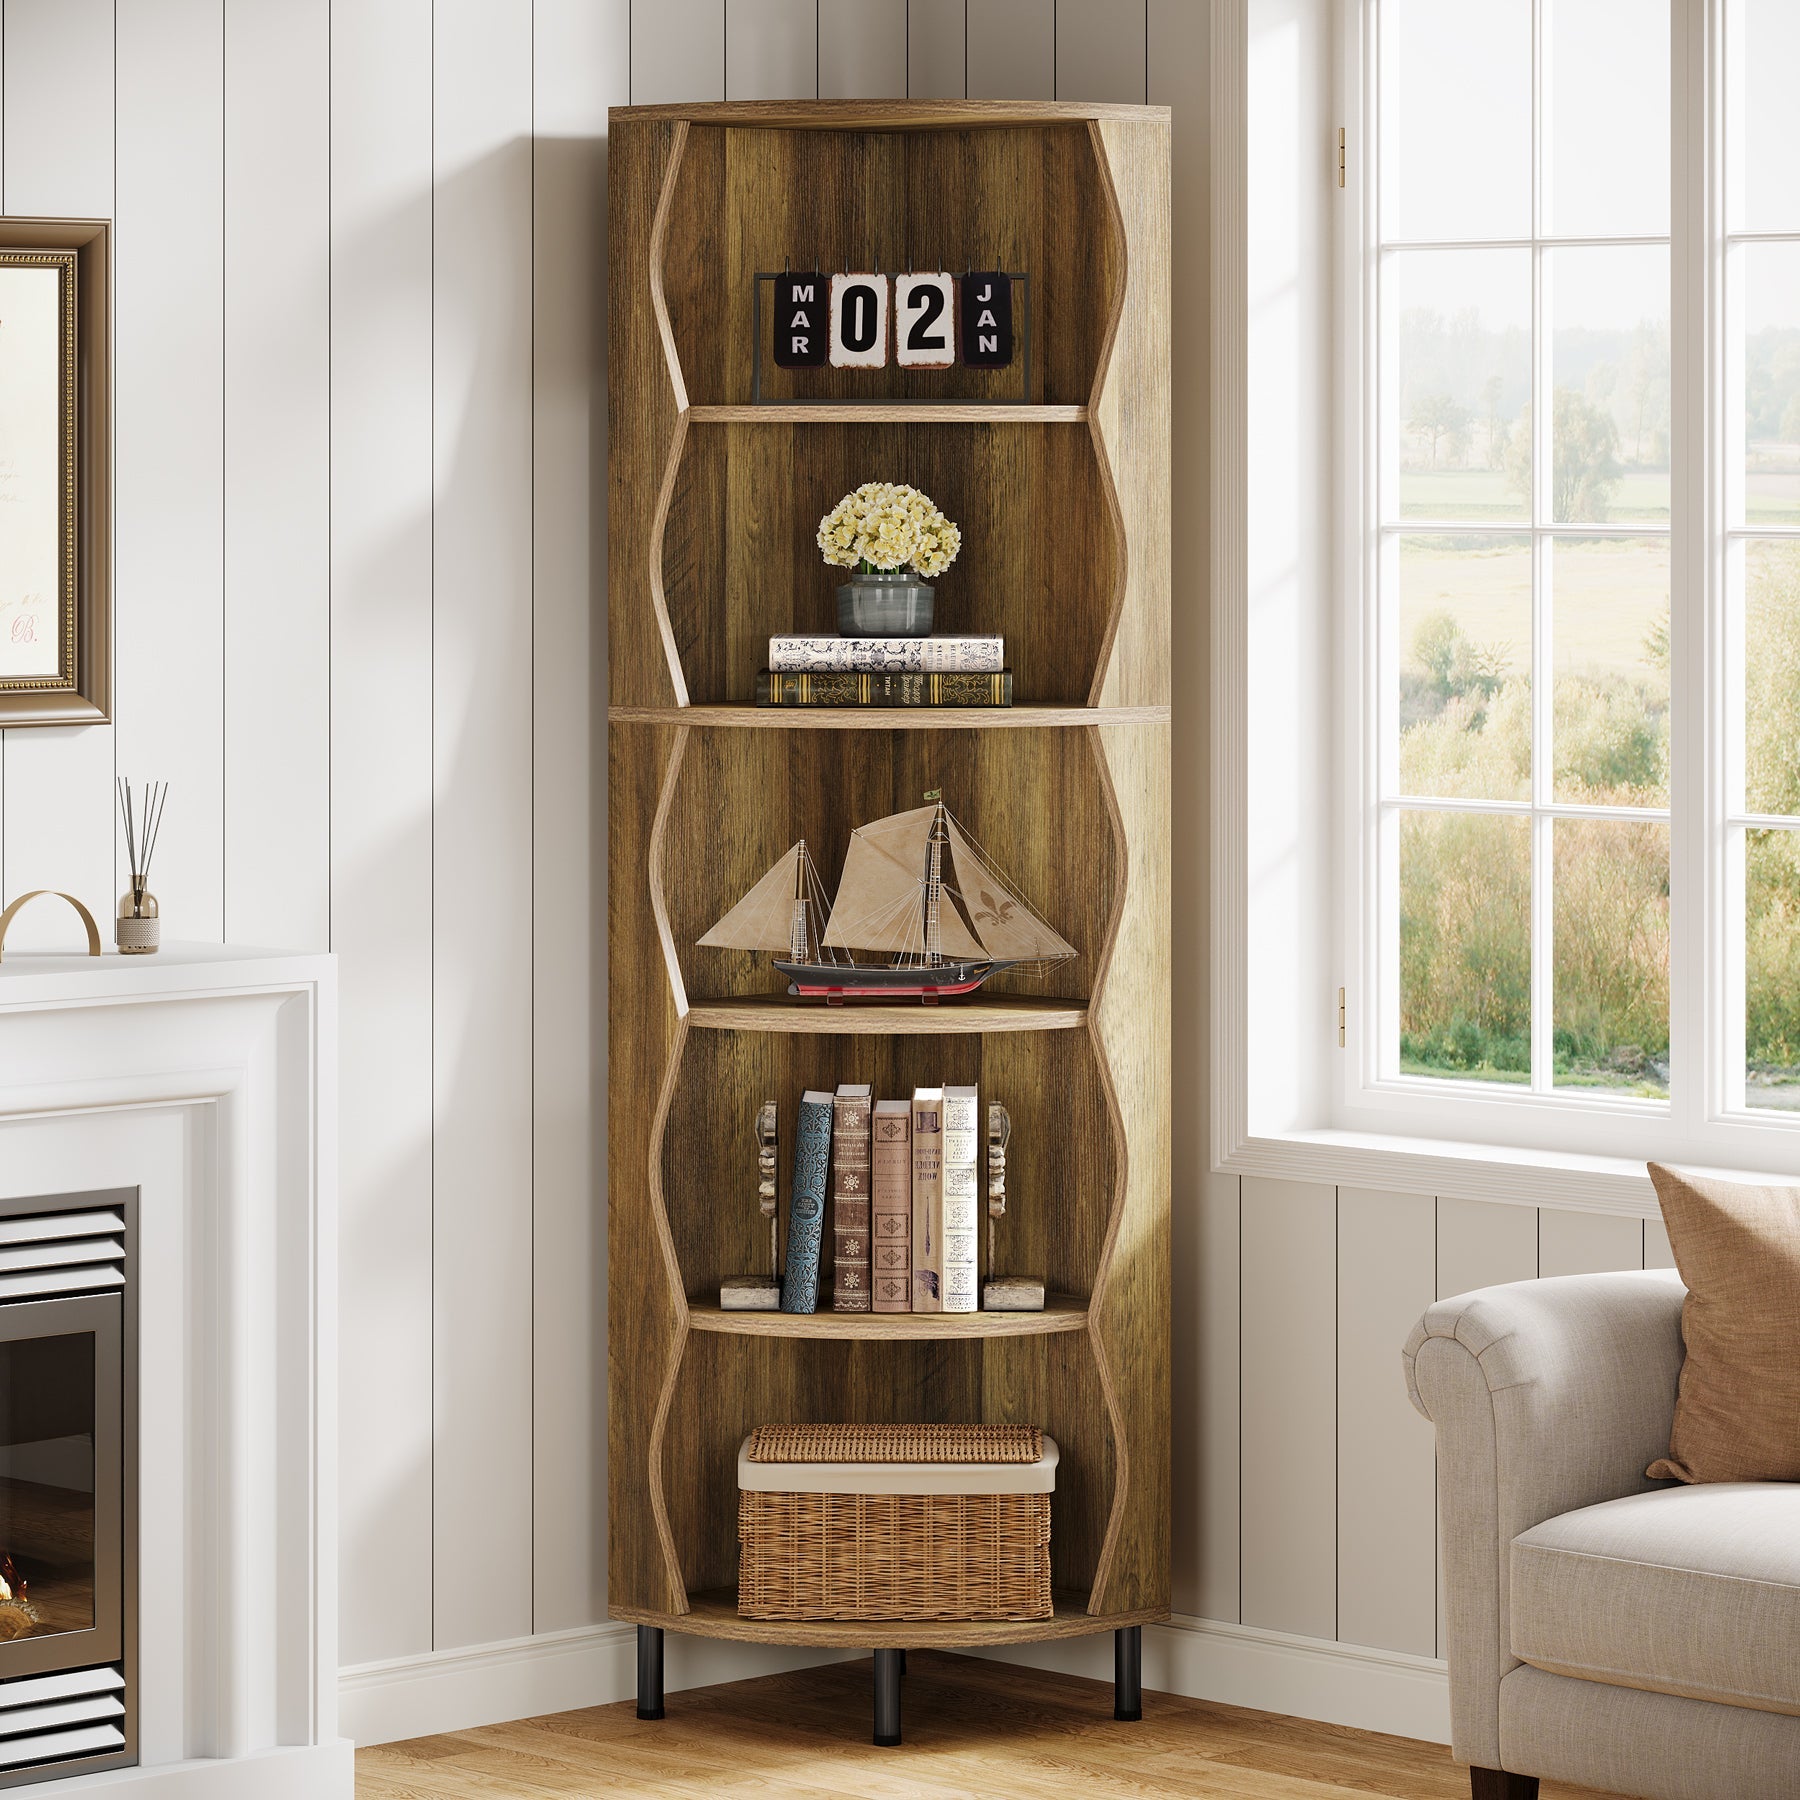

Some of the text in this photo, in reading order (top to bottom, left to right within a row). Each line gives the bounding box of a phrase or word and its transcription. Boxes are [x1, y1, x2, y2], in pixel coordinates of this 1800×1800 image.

[790, 285, 814, 354] MAR
[976, 284, 998, 353] JAN
[901, 674, 913, 704] Драйзер
